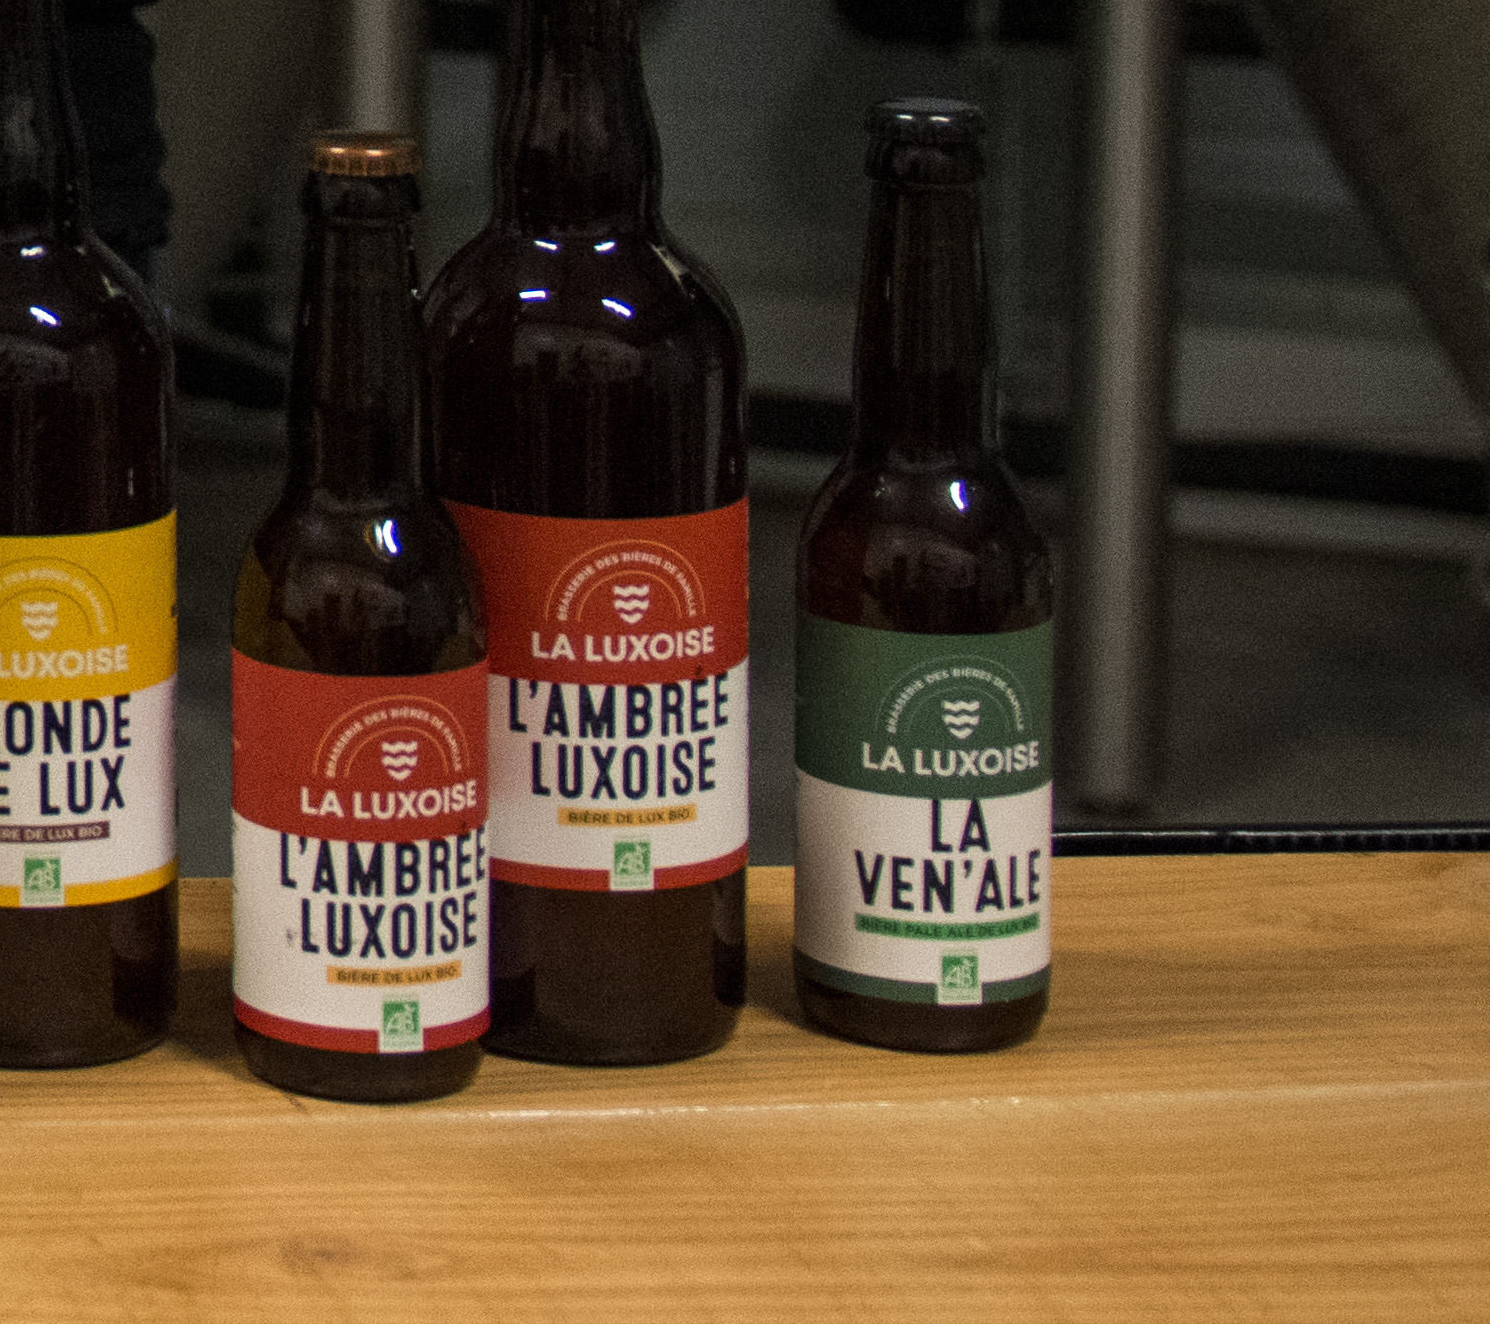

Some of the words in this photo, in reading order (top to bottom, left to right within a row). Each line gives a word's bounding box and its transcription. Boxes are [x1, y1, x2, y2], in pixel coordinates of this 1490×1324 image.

[530, 630, 576, 661] LA
[584, 626, 715, 662] LUXOISE
[531, 736, 716, 800] LUXOISE
[862, 741, 905, 774] LA
[913, 740, 1040, 776] LUXOISE
[39, 754, 125, 816] LUX
[300, 786, 344, 818] LA
[353, 779, 477, 820] LUXOISE
[47, 826, 75, 839] LUX
[78, 824, 103, 838] BIO
[615, 812, 634, 824] DE
[638, 810, 664, 823] LUX
[669, 807, 691, 821] BIO
[930, 799, 991, 853] LA
[854, 849, 1041, 913] VEN'ALE
[301, 891, 478, 959] LUXOISE
